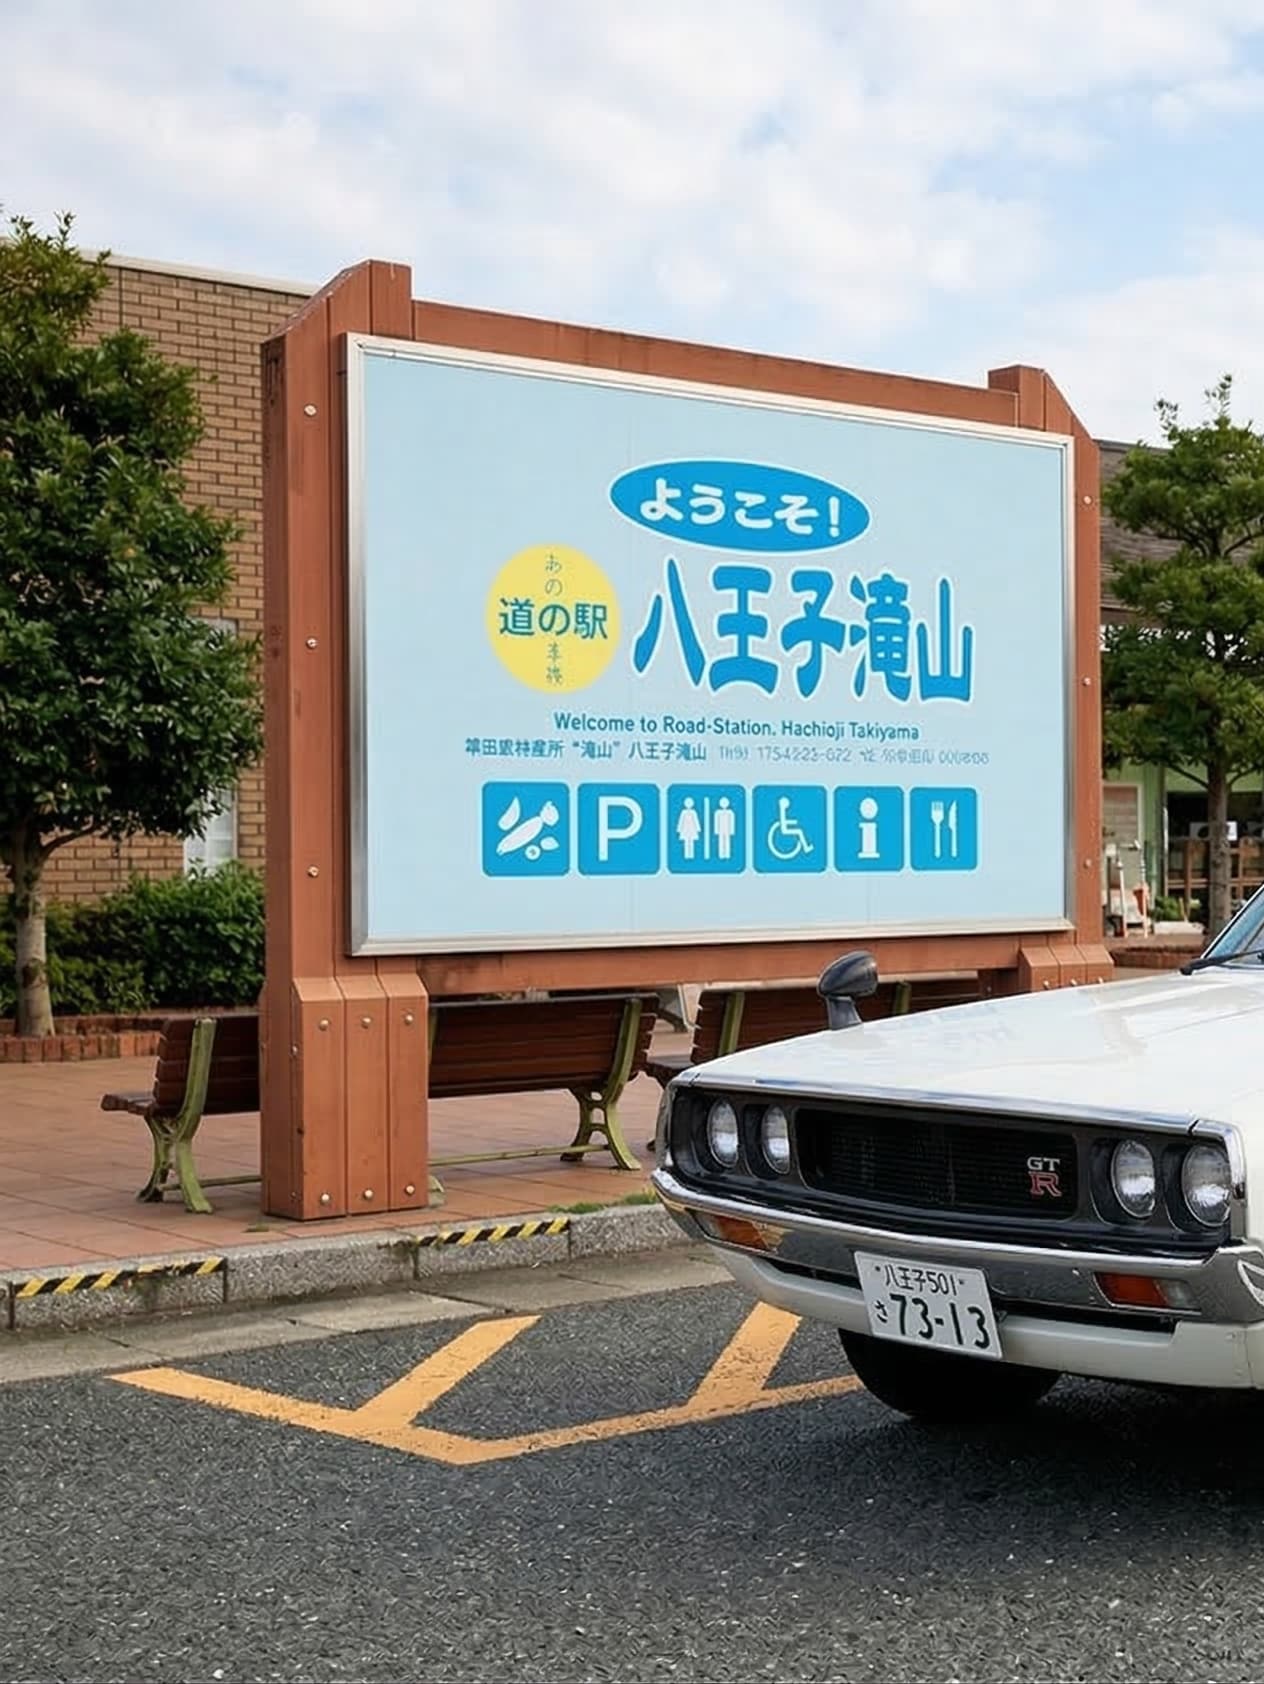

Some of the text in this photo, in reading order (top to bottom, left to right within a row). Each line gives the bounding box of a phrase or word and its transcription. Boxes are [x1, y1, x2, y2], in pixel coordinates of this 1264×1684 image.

[498, 597, 608, 639] 道の駅
[633, 558, 973, 702] 八王子滝山
[554, 712, 635, 732] Welcome
[640, 716, 657, 733] to
[782, 720, 845, 741] Hachioji
[850, 722, 920, 743] Takiyama
[628, 741, 707, 761] 八王子滝山
[598, 795, 643, 861] P
[1027, 1156, 1061, 1171] GT
[1028, 1171, 1062, 1197] R
[885, 1264, 957, 1296] 八王子501
[874, 1293, 991, 1349] さ 73-13
